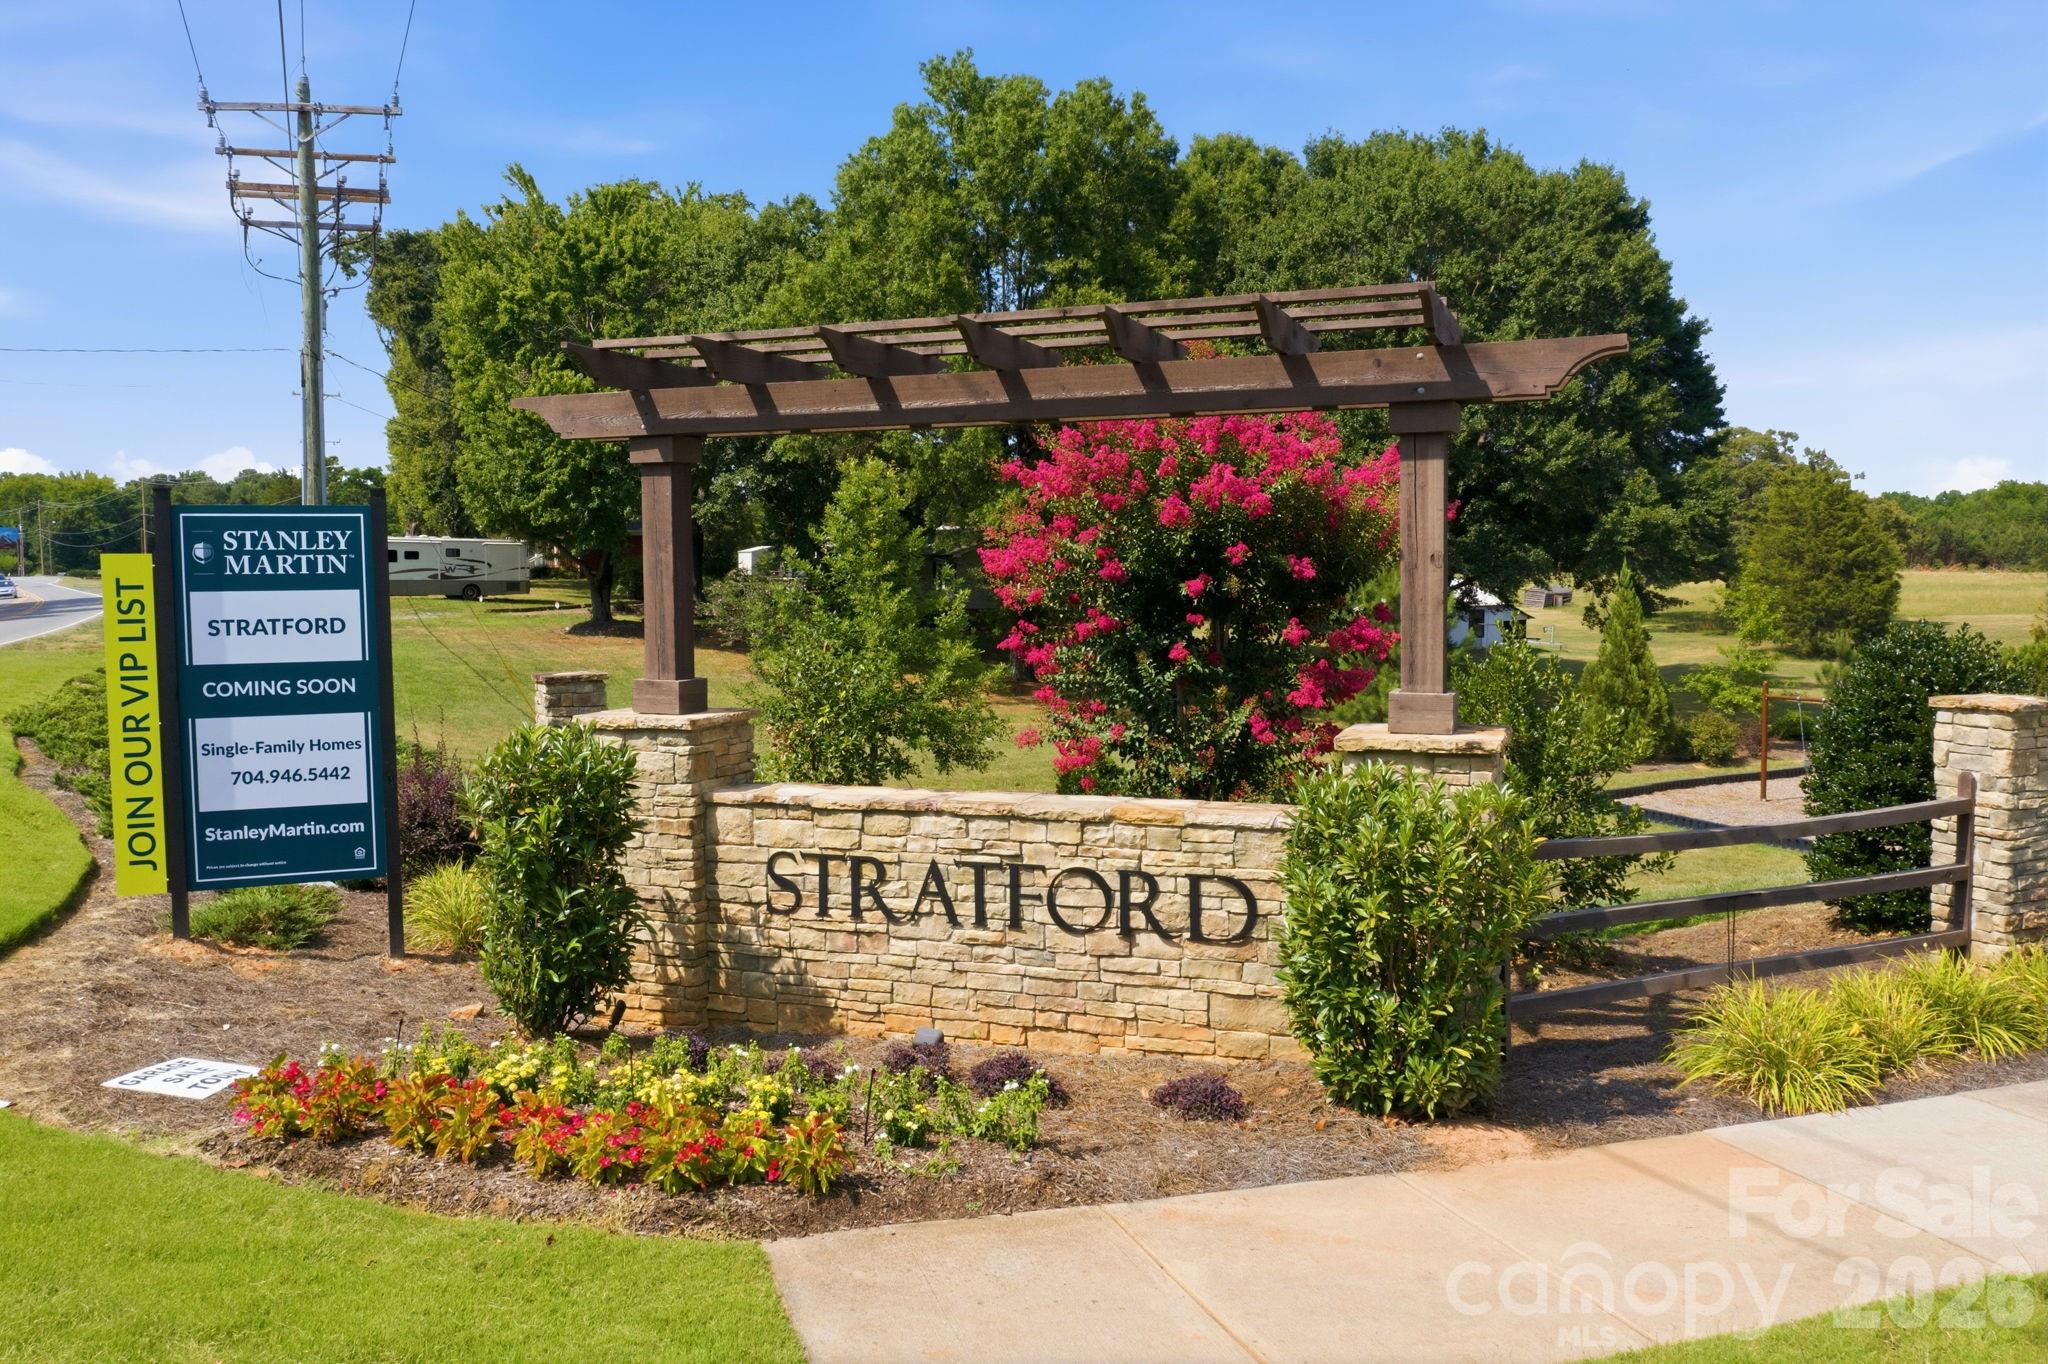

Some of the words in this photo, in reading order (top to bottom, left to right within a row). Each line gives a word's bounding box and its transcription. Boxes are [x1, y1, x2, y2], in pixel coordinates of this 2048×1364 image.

[223, 530, 352, 551] STANLEY
[224, 554, 347, 575] MARTIN
[115, 577, 147, 642] LIST
[207, 617, 347, 637] STRATFORD
[118, 652, 150, 707] VIP
[202, 680, 292, 698] COMING
[296, 678, 357, 696] SOON
[122, 712, 153, 786] OUR
[201, 739, 306, 758] Single-Family
[310, 738, 362, 752] Homes
[231, 766, 351, 786] 704.946.5442
[125, 796, 158, 871] JOIN
[205, 821, 365, 842] StanleyMartin.com
[766, 850, 1259, 943] STRATFORD
[162, 1067, 216, 1084] SALE
